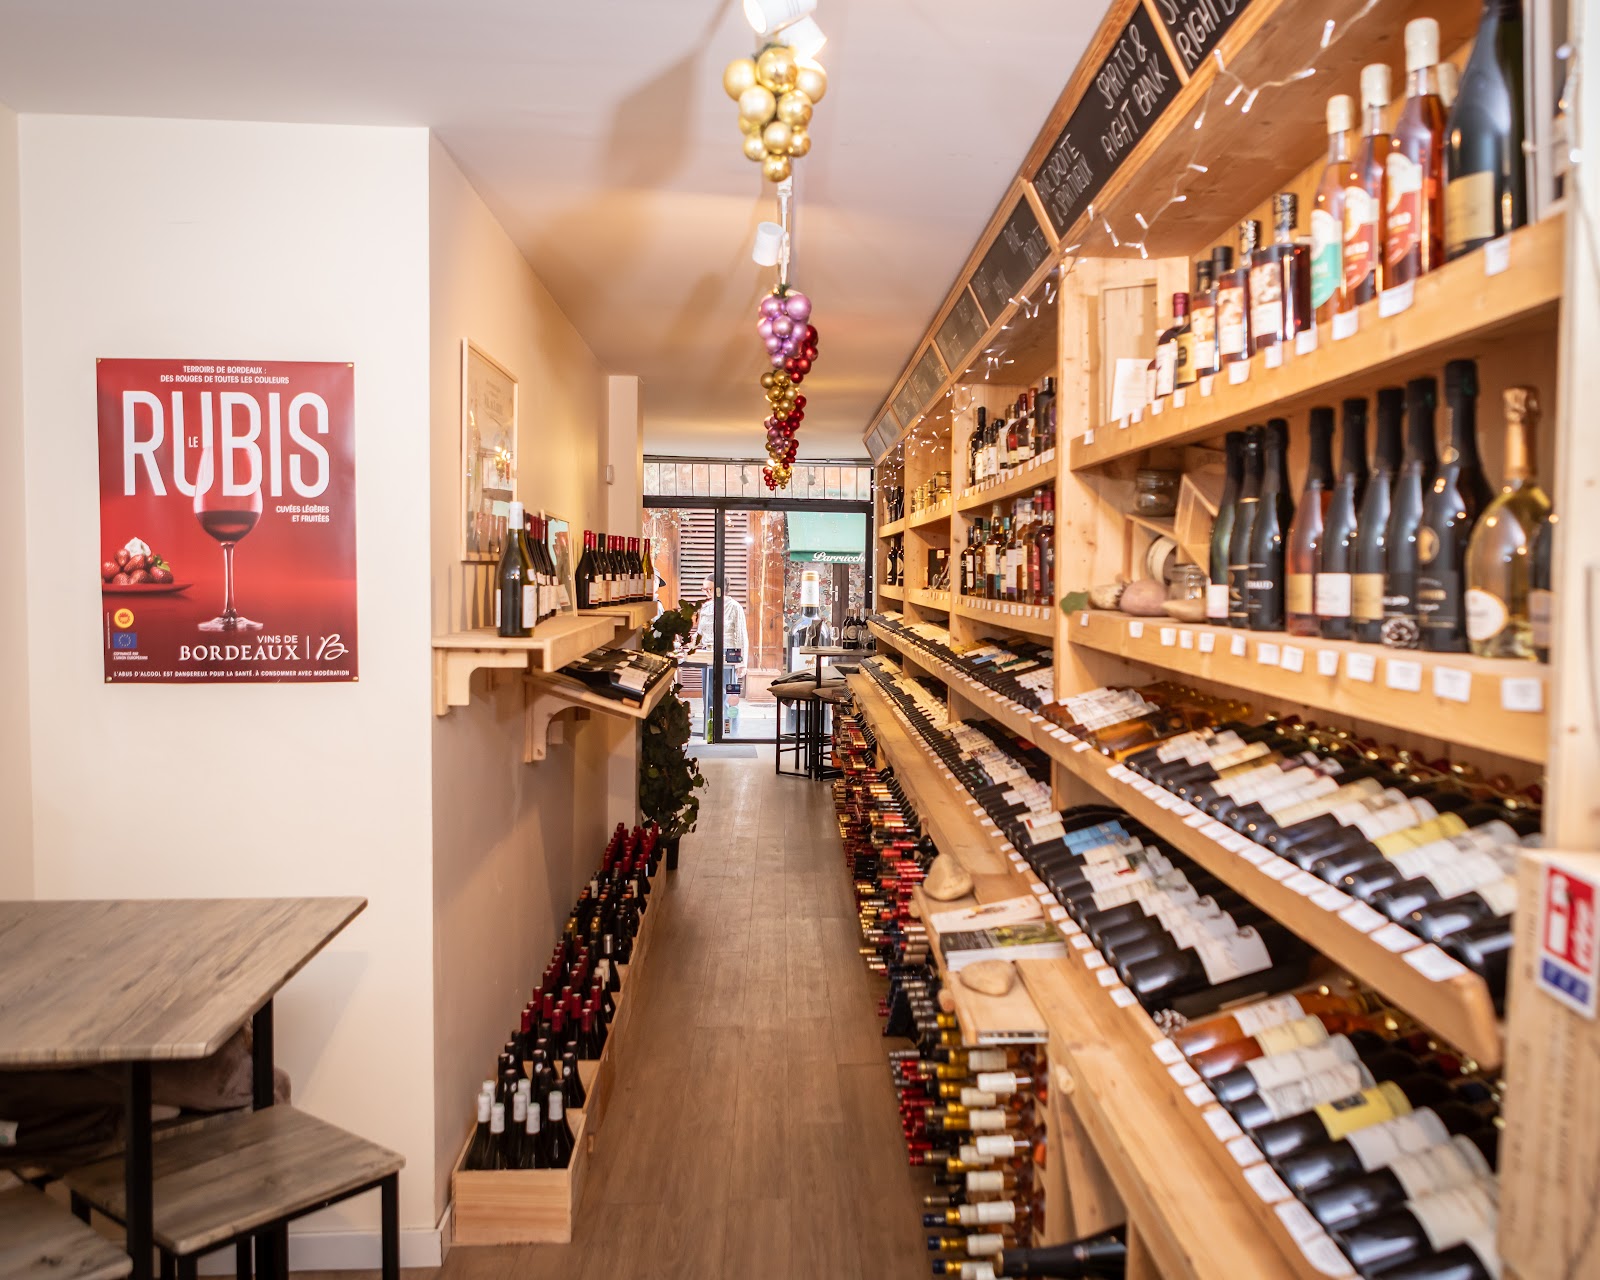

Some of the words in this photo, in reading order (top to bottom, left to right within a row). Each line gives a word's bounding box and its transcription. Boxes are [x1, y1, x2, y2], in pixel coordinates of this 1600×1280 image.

[1129, 23, 1148, 63] &
[1100, 98, 1139, 162] RIGHT
[1131, 52, 1170, 117] BANK
[183, 365, 215, 373] TERROIRS
[216, 366, 225, 374] DE
[227, 366, 263, 374] BORDEAUX
[160, 374, 174, 383] DES
[175, 375, 202, 383] ROUGES
[204, 375, 213, 383] DE
[214, 375, 240, 384] TOUTES
[240, 376, 253, 384] LES
[254, 376, 290, 384] COULEURS
[122, 390, 330, 498] RUBIS
[188, 436, 198, 448] LE
[276, 504, 301, 513] CUVÉES
[302, 504, 330, 513] LÉGÈRES
[292, 514, 299, 523] ET
[301, 514, 330, 523] FRUITÉES
[257, 635, 281, 644] VINS
[284, 635, 298, 644] DE
[178, 644, 301, 661] BORDEAUX
[314, 669, 350, 677] MODÉRATION
